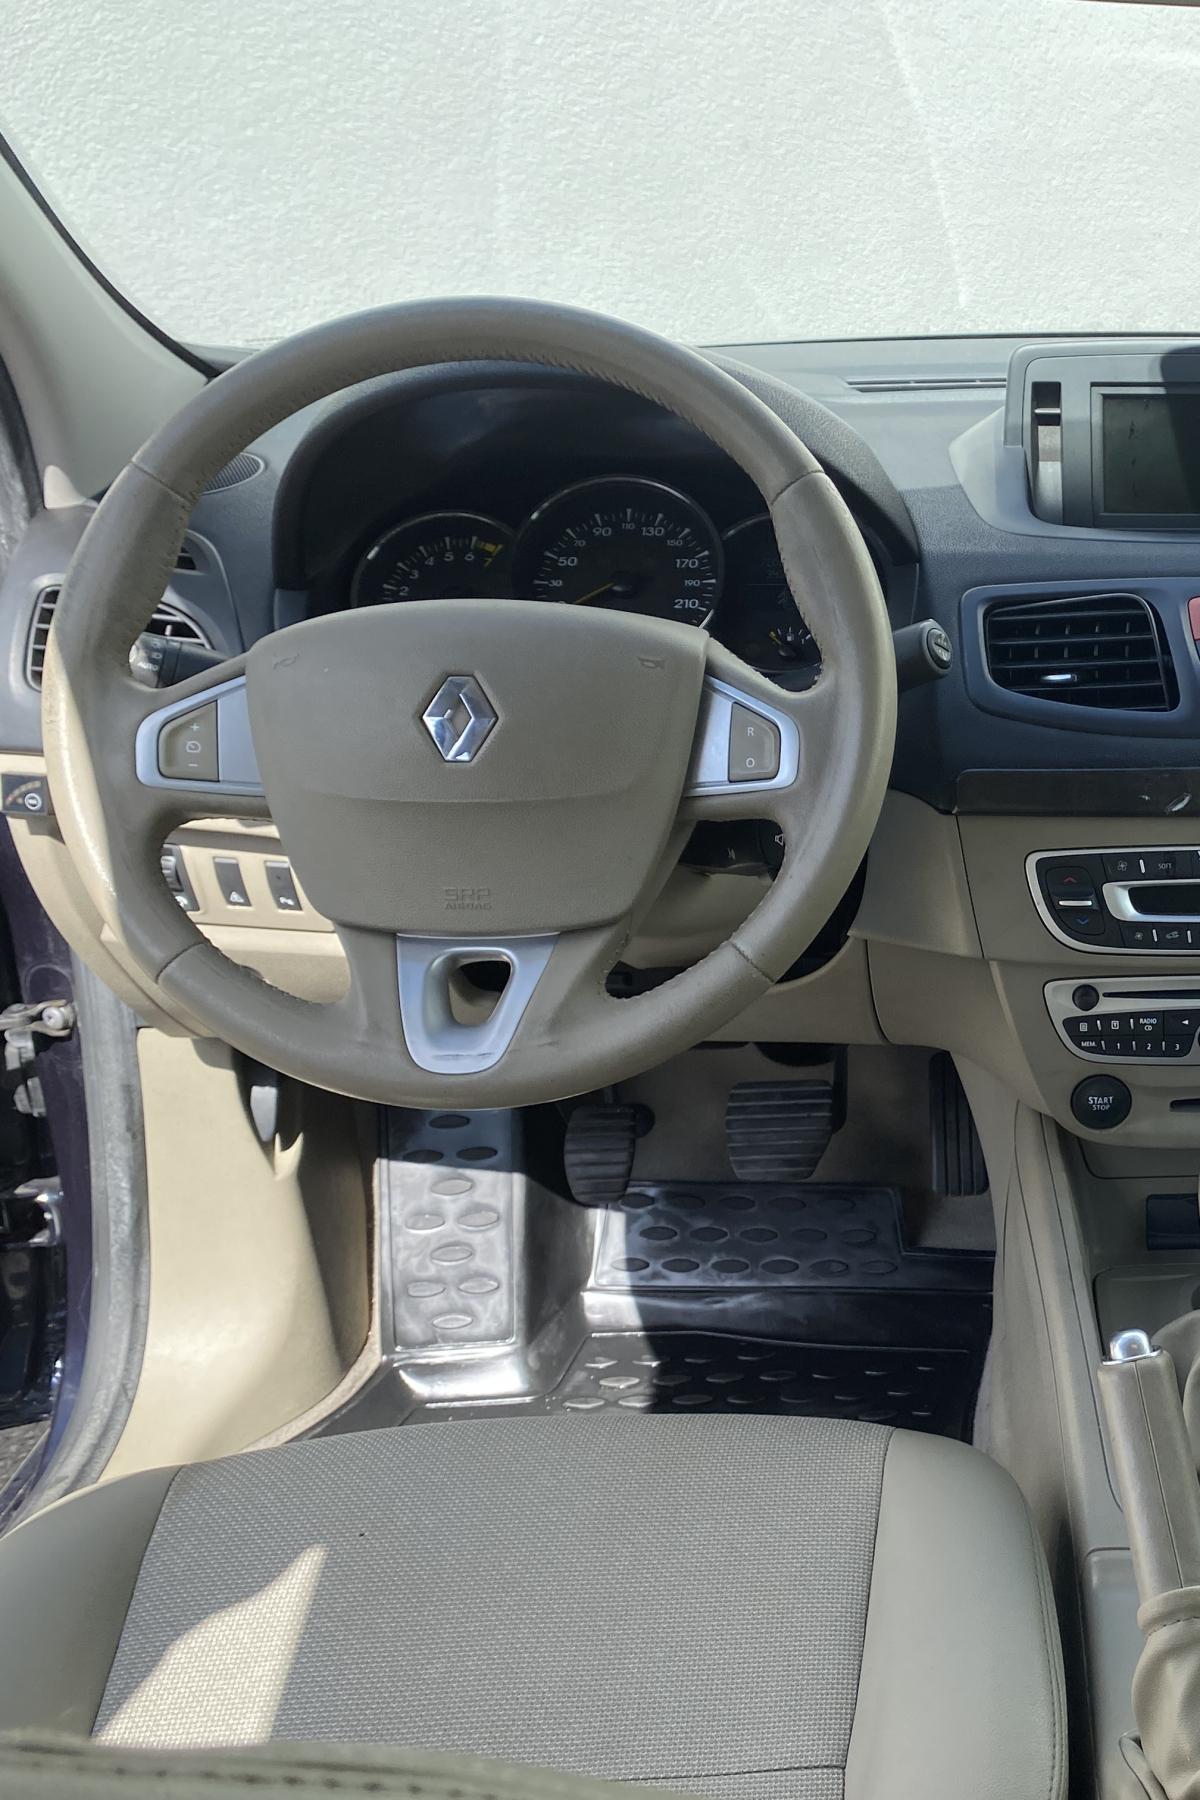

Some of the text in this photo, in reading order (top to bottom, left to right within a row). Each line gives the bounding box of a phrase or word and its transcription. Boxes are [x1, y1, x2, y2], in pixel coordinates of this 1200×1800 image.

[622, 522, 635, 530] 110
[592, 527, 612, 537] 90
[641, 527, 665, 537] 130
[444, 551, 454, 562] 5
[464, 551, 474, 561] 6
[558, 556, 578, 567] 50
[675, 558, 699, 569] 170
[409, 569, 419, 579] 3
[549, 579, 563, 587] 30
[684, 579, 701, 587] 190
[673, 599, 699, 609] 210
[747, 726, 754, 737] R
[1088, 1096, 1113, 1104] START
